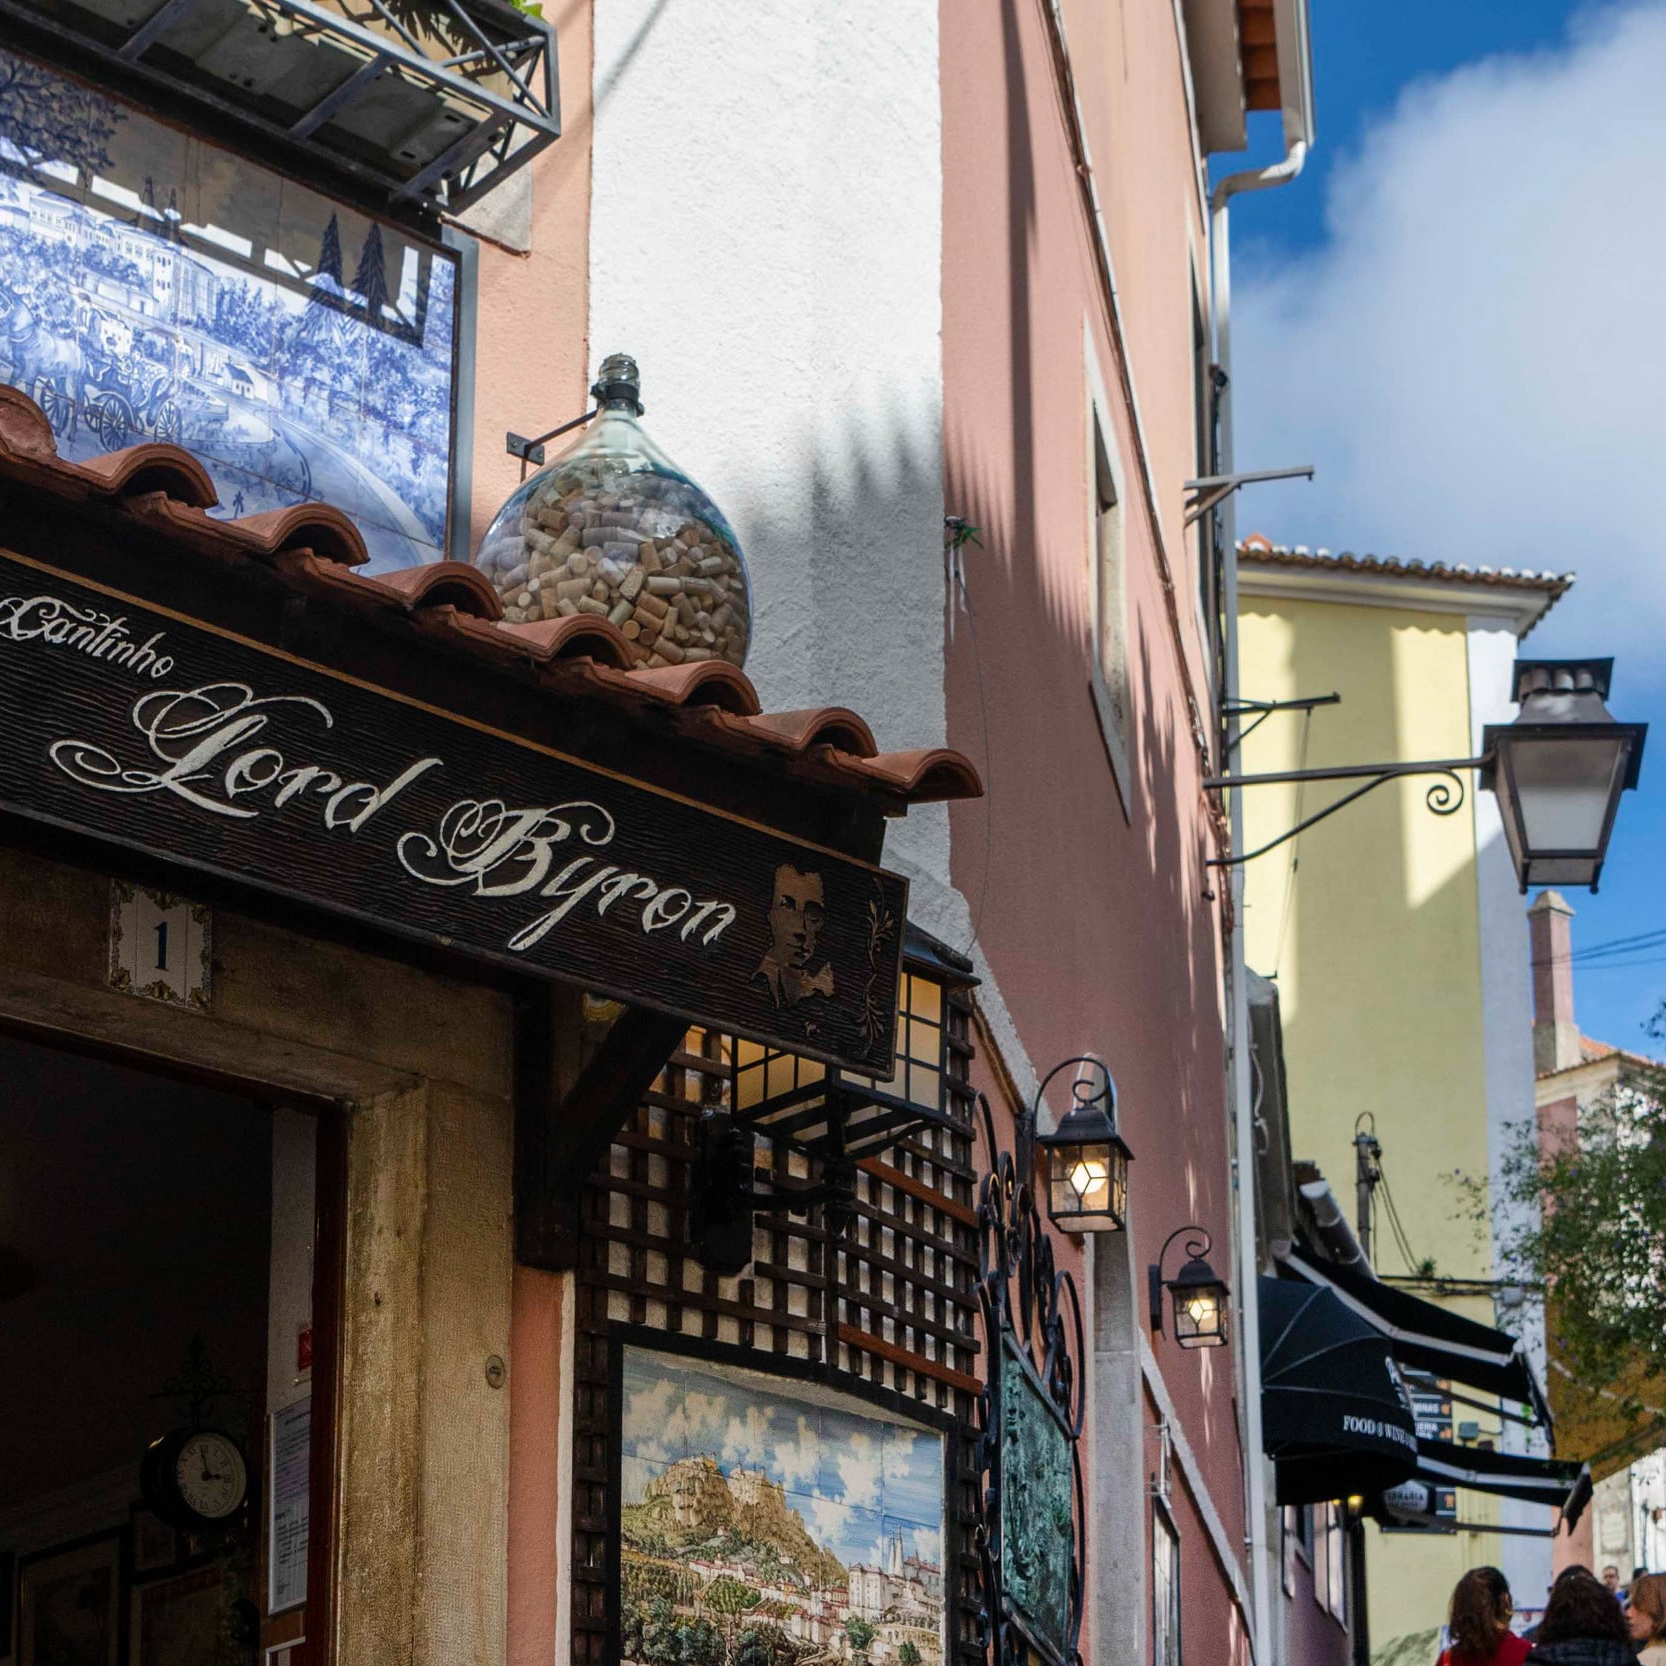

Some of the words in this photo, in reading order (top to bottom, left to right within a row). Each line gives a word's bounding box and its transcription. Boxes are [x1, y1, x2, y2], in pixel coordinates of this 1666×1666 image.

[49, 682, 445, 834] Lord
[396, 797, 737, 953] Byron
[154, 920, 169, 972] 1
[1343, 1414, 1377, 1436] FOOD
